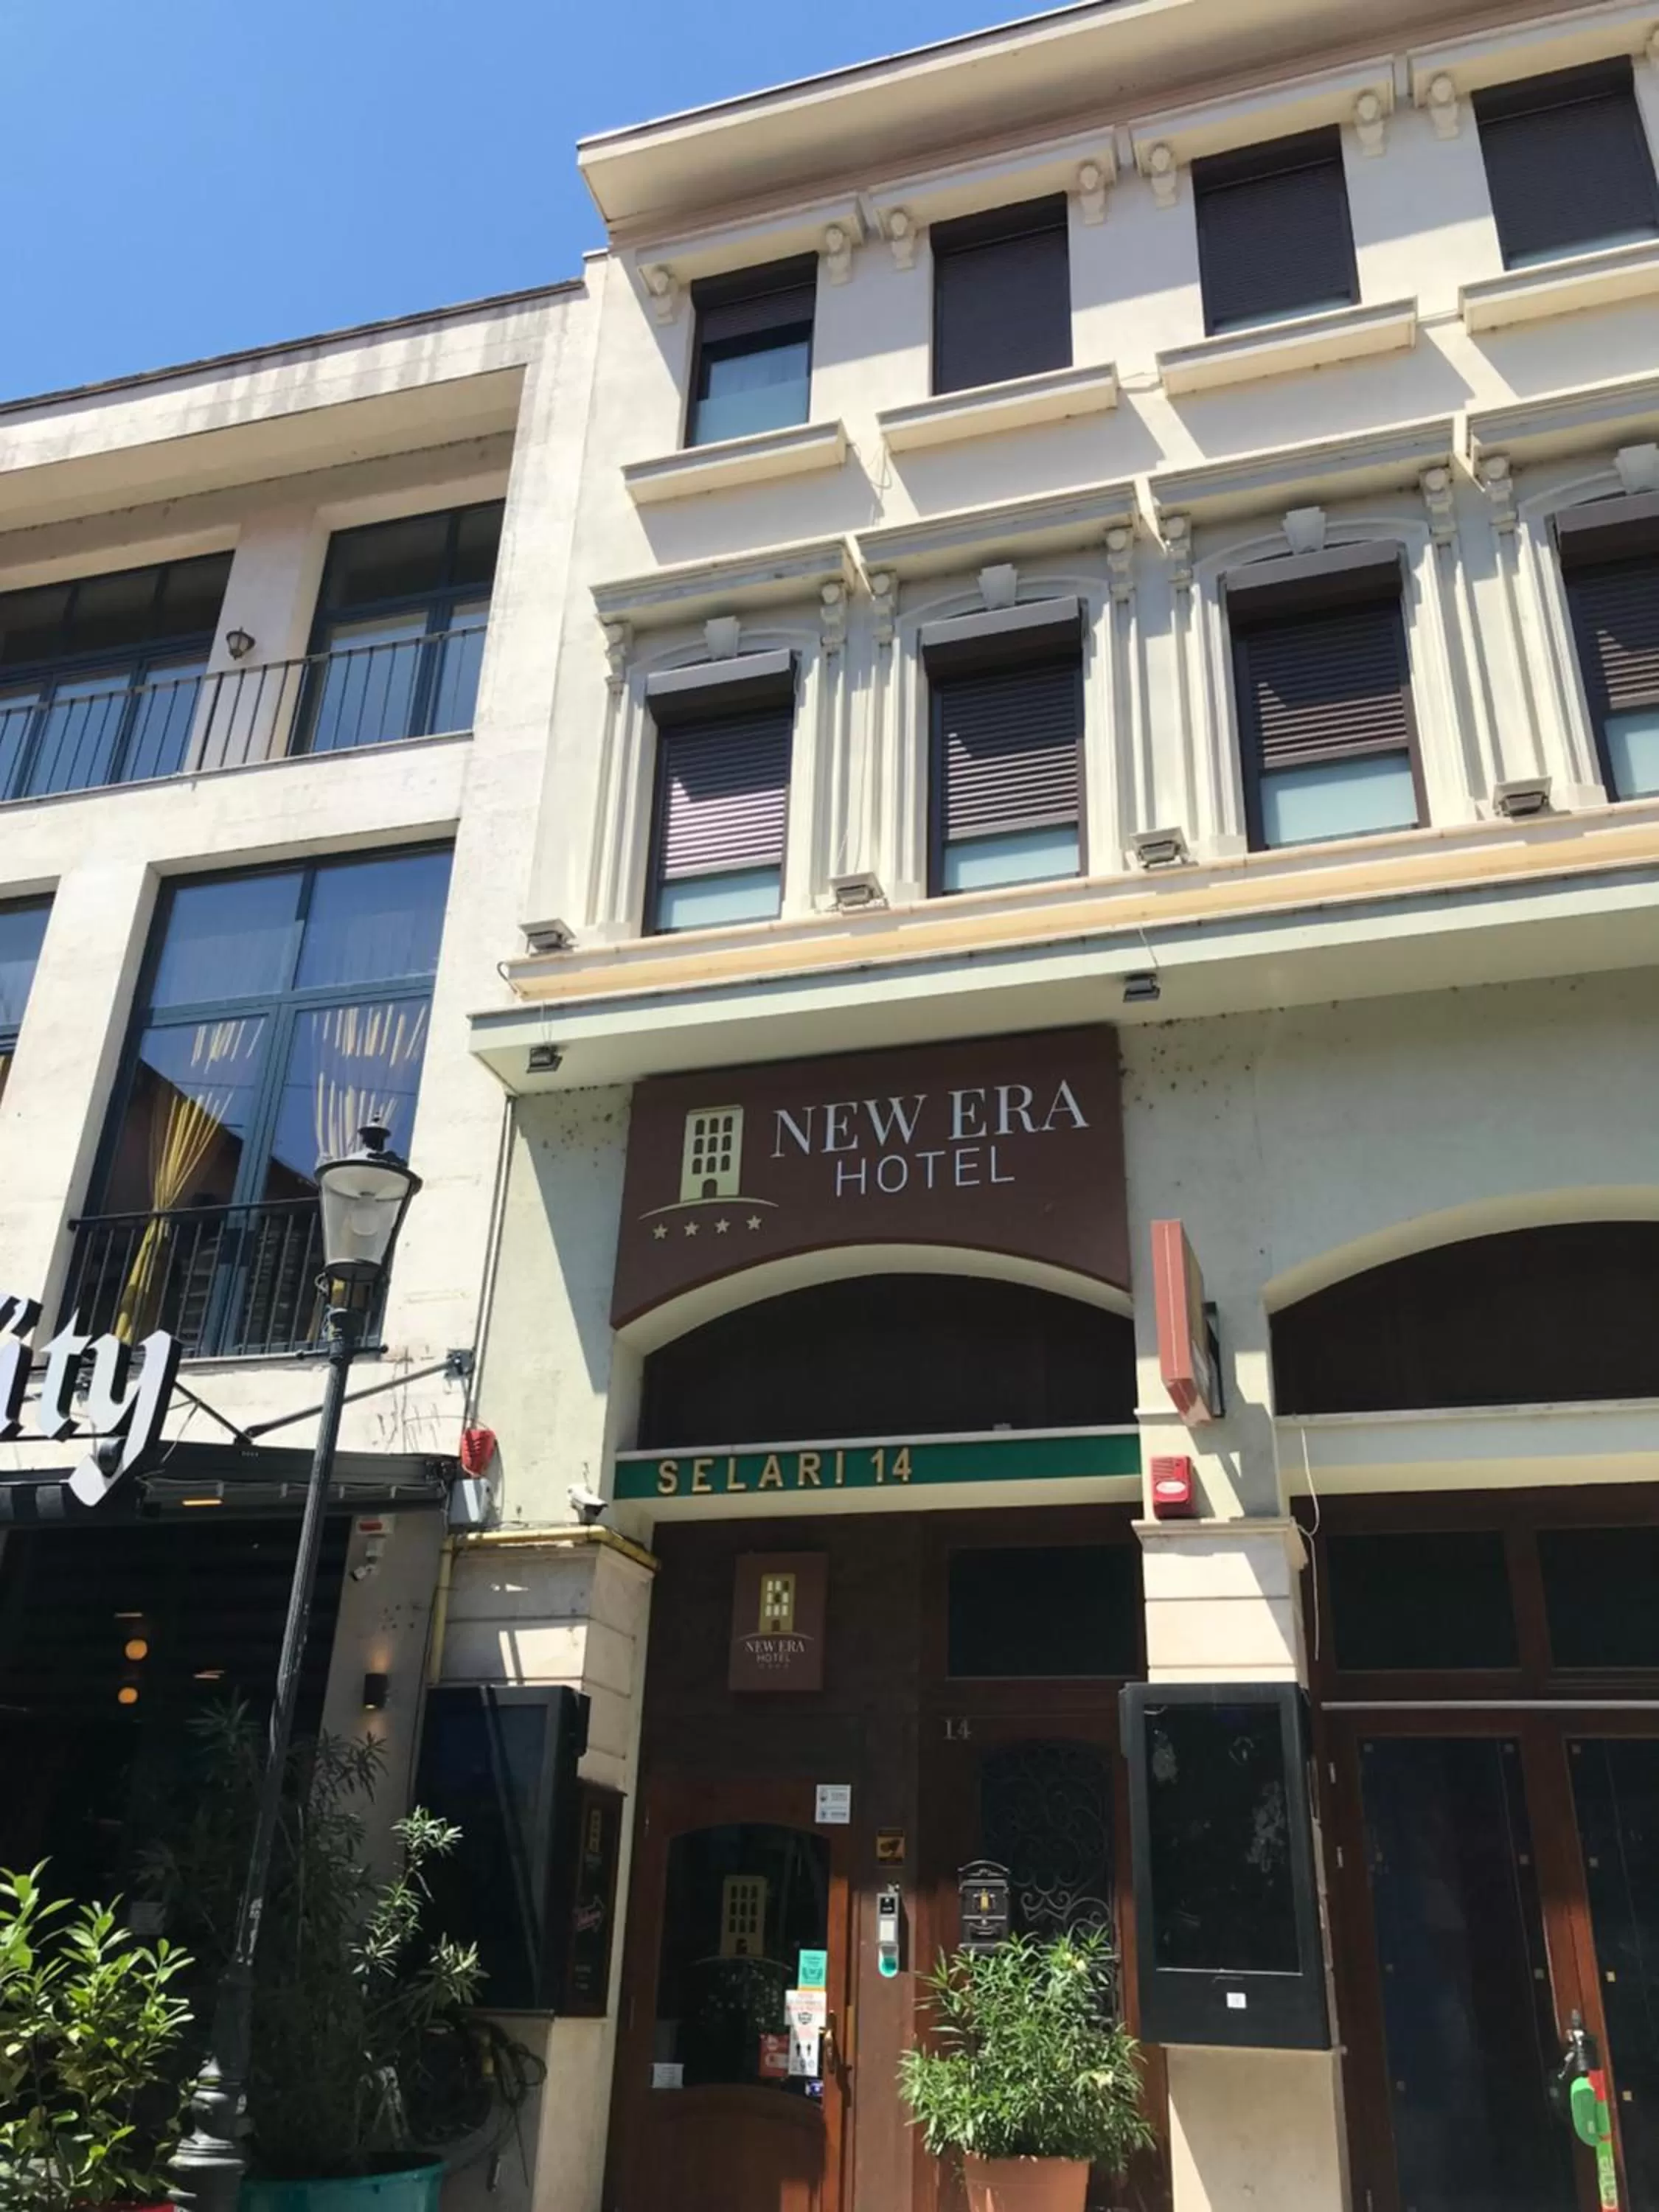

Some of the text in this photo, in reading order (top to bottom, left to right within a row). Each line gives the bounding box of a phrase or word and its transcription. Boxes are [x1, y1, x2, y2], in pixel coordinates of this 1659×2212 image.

[769, 1079, 1091, 1158] NEW ERA
[835, 1145, 1015, 1197] HOTEL
[656, 1446, 912, 1495] SELARI 14
[943, 1717, 972, 1741] 14
